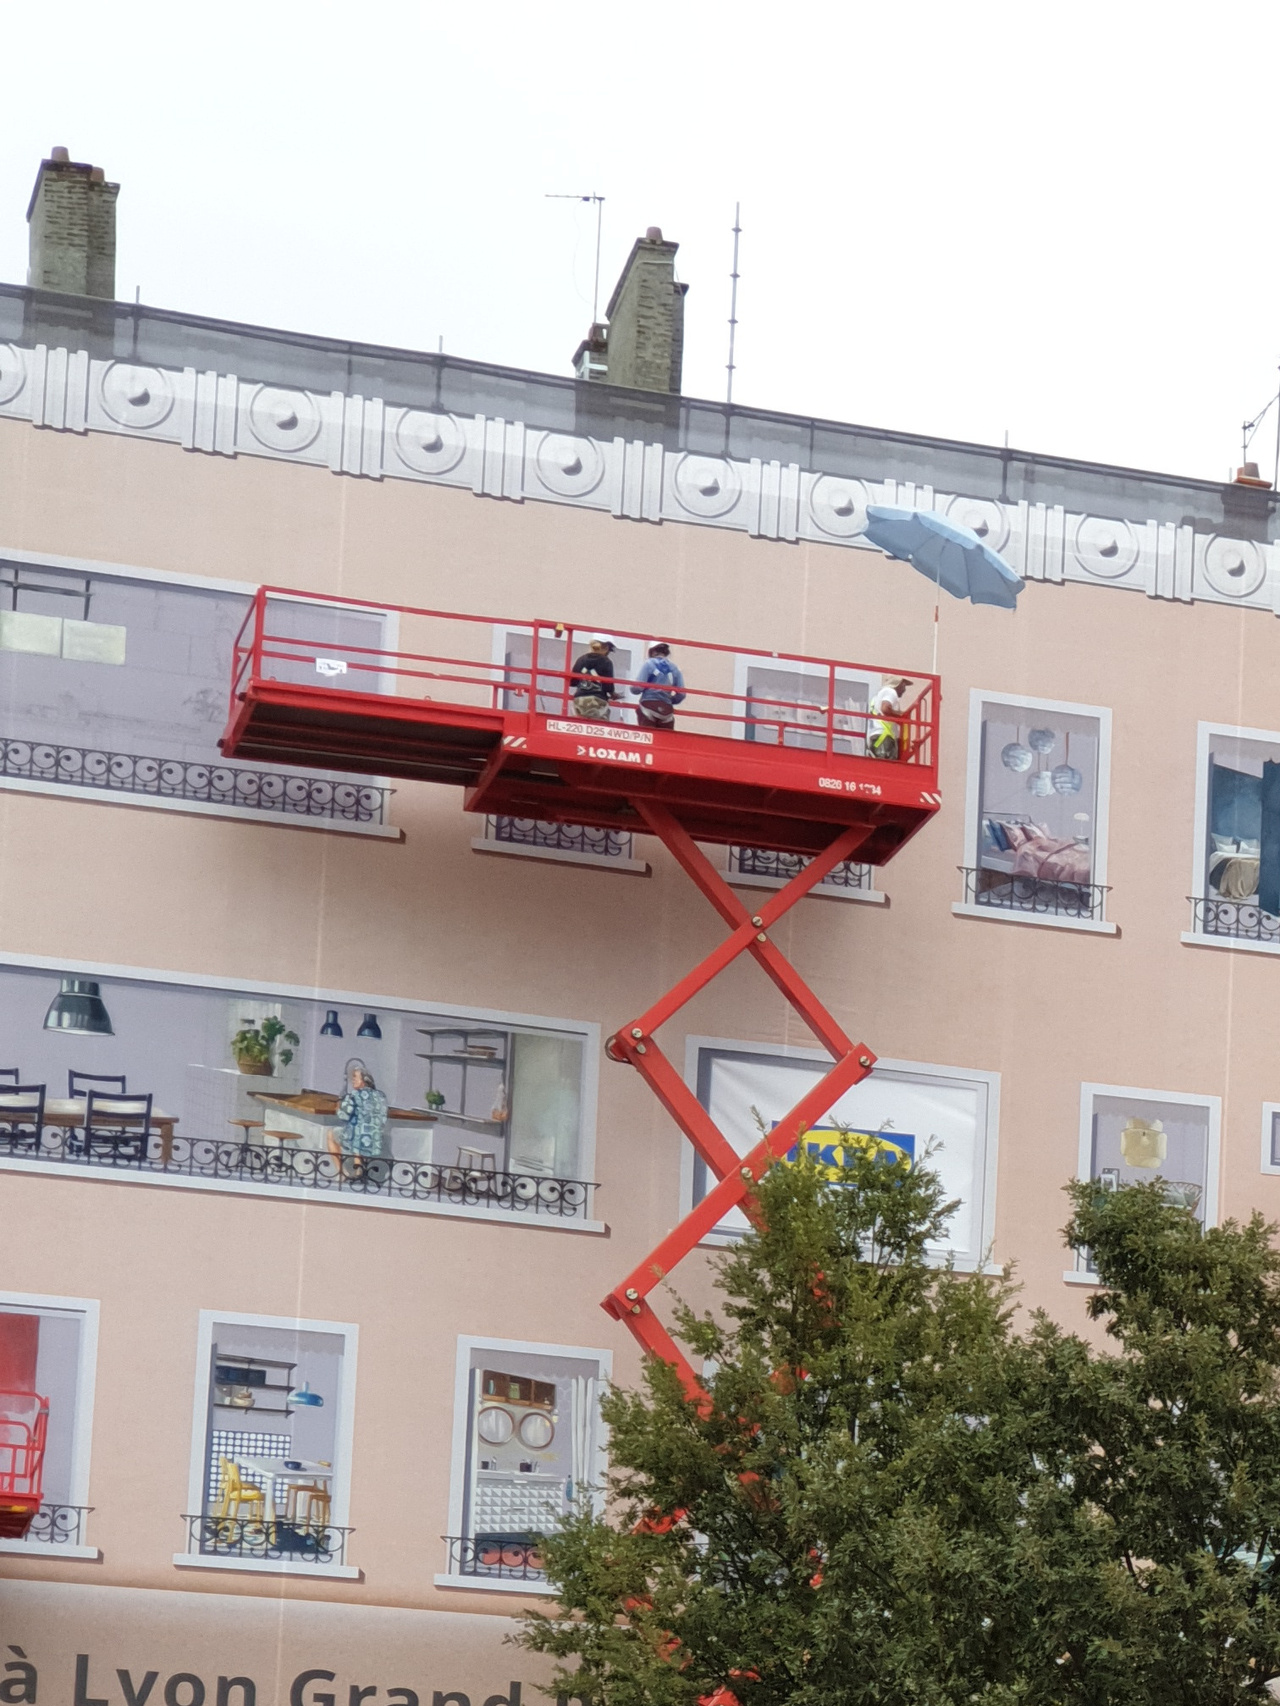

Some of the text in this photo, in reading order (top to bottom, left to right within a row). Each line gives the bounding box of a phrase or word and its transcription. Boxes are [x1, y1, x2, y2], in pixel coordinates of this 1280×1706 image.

[547, 721, 583, 733] HL-220
[586, 725, 605, 736] D25
[588, 746, 641, 764] LOXAM
[844, 781, 857, 792] 16
[0, 1645, 38, 1705] à
